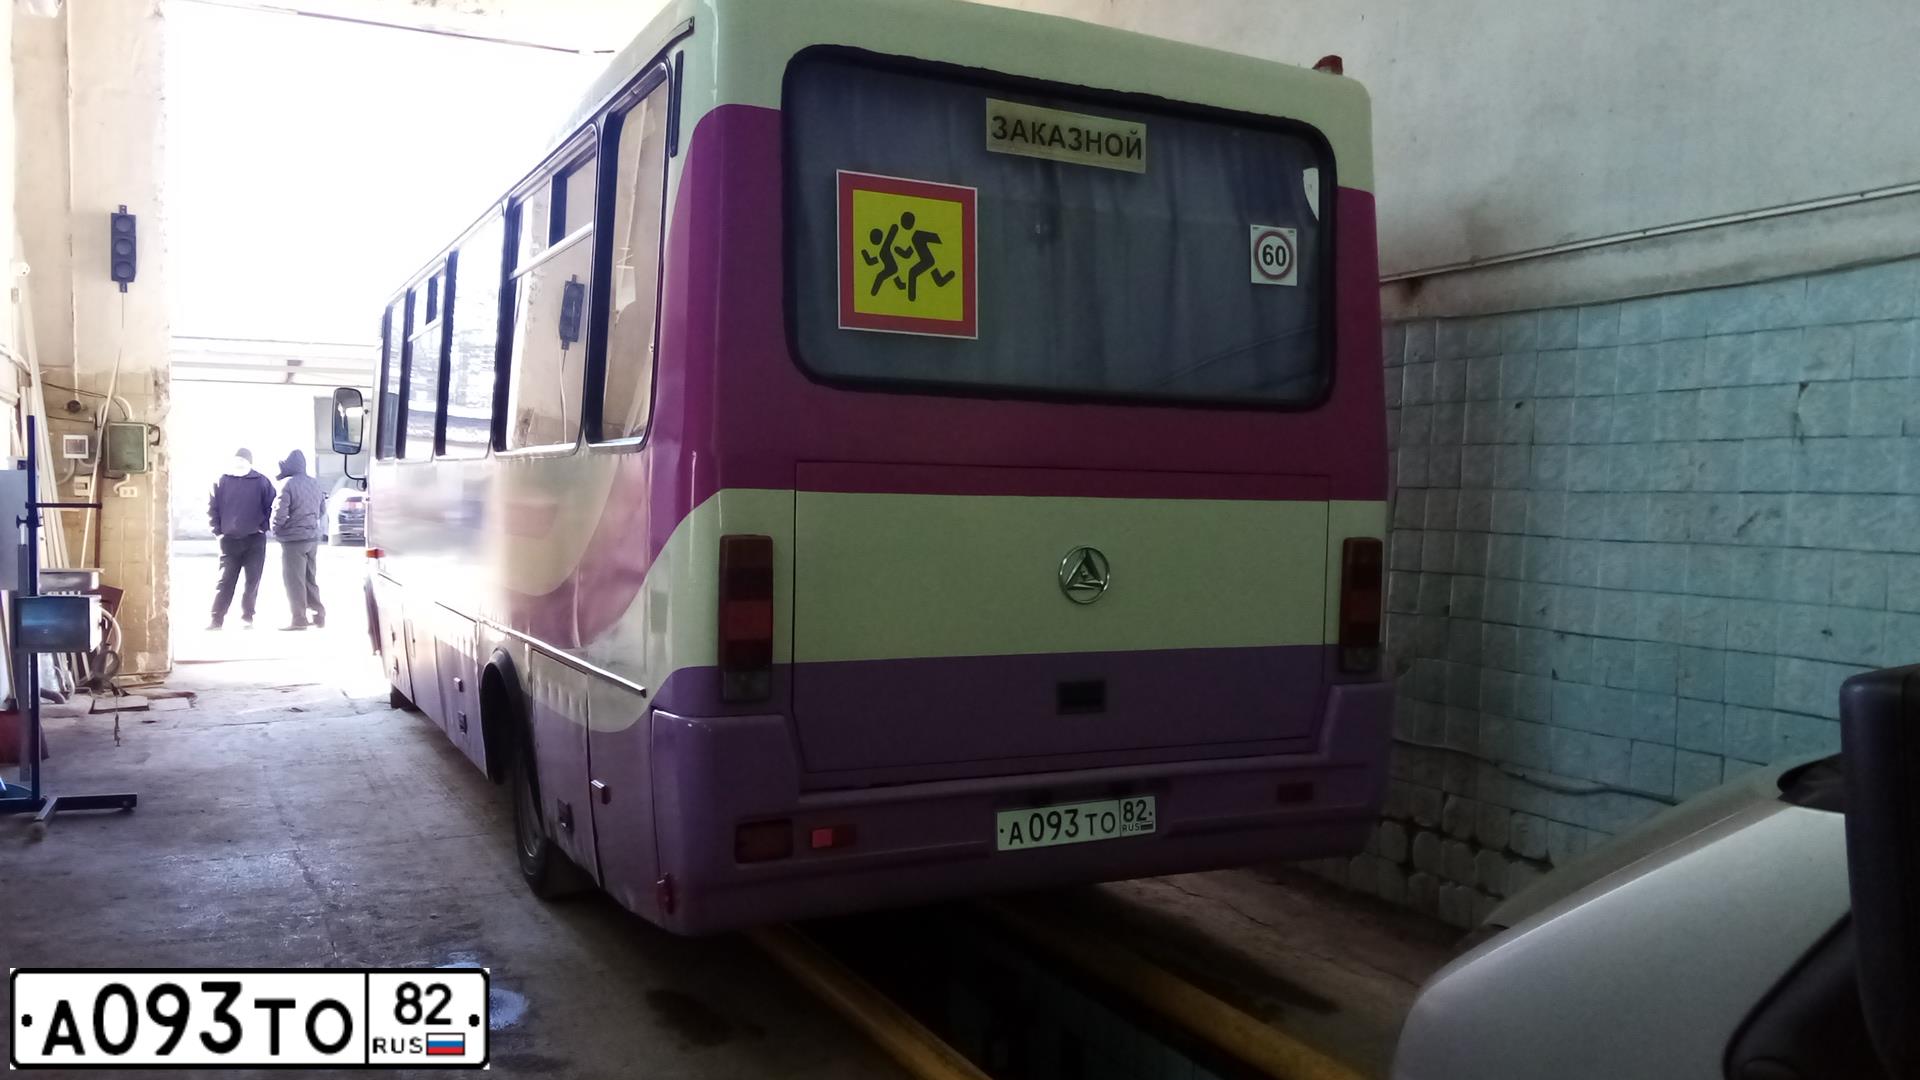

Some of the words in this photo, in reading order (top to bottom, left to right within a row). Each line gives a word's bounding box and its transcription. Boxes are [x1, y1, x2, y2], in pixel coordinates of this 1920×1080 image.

[991, 115, 1142, 160] ЗАКАЗНОЙ
[1262, 244, 1287, 267] 60
[1123, 800, 1147, 822] 82
[1121, 823, 1140, 832] RUS
